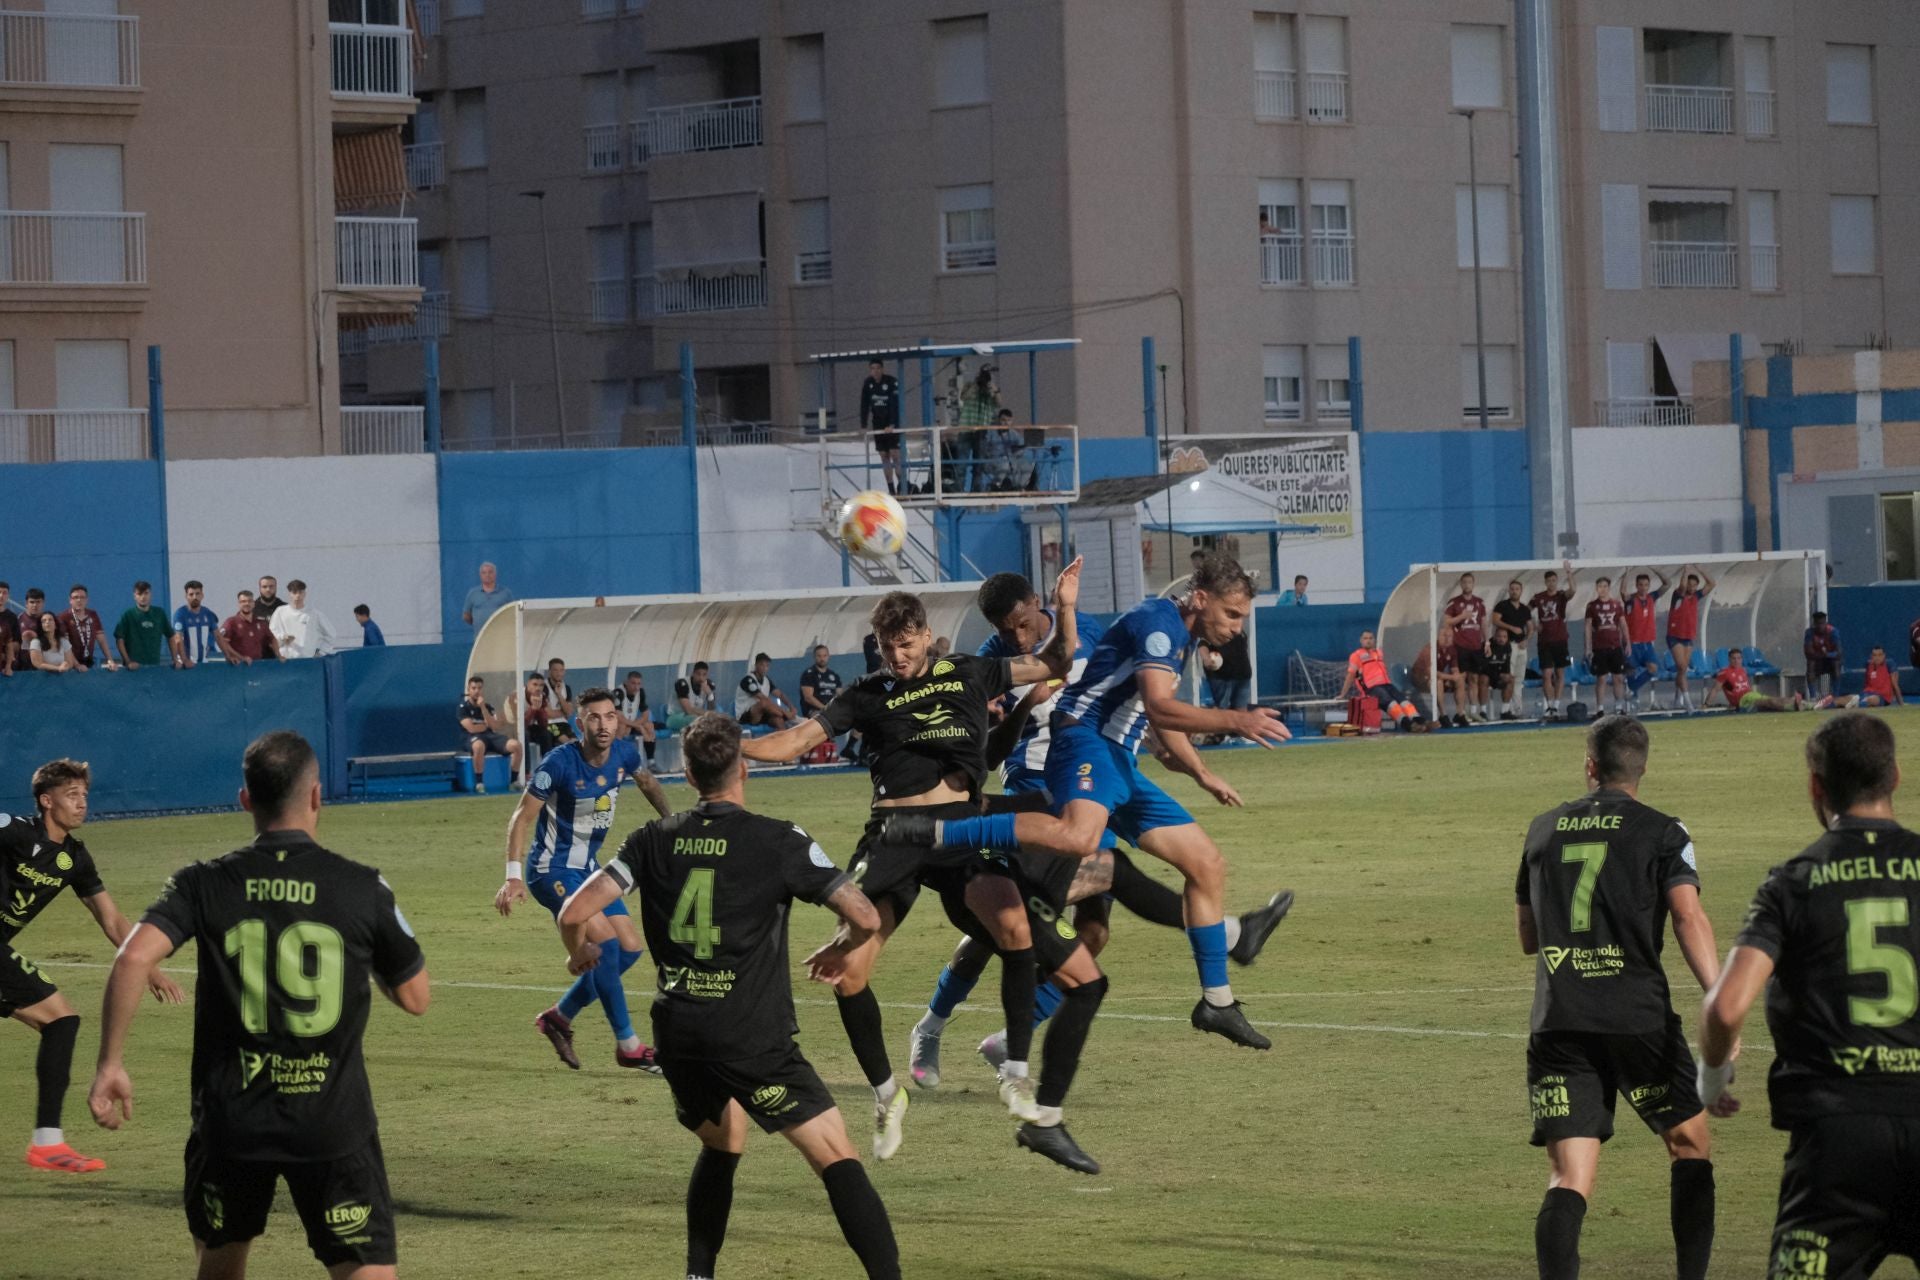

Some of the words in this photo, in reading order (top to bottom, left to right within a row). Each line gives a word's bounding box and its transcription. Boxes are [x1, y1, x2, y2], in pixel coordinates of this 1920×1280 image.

[1272, 453, 1346, 475] PUBLICITARTE
[1266, 481, 1278, 492] EN
[1280, 480, 1300, 491] ESTE
[1279, 489, 1349, 515] LEMÁTICO?
[1556, 815, 1623, 832] BARACE
[674, 838, 727, 856] PARDO
[1808, 857, 1883, 889] ANGEL
[245, 878, 316, 905] FRODO
[553, 881, 566, 897] 6
[1562, 841, 1608, 932] 7
[670, 868, 721, 959] 4
[1572, 944, 1625, 961] Reynolds
[1572, 958, 1624, 970] Verdasco
[1844, 898, 1919, 1028] 5
[225, 918, 345, 1038] 19
